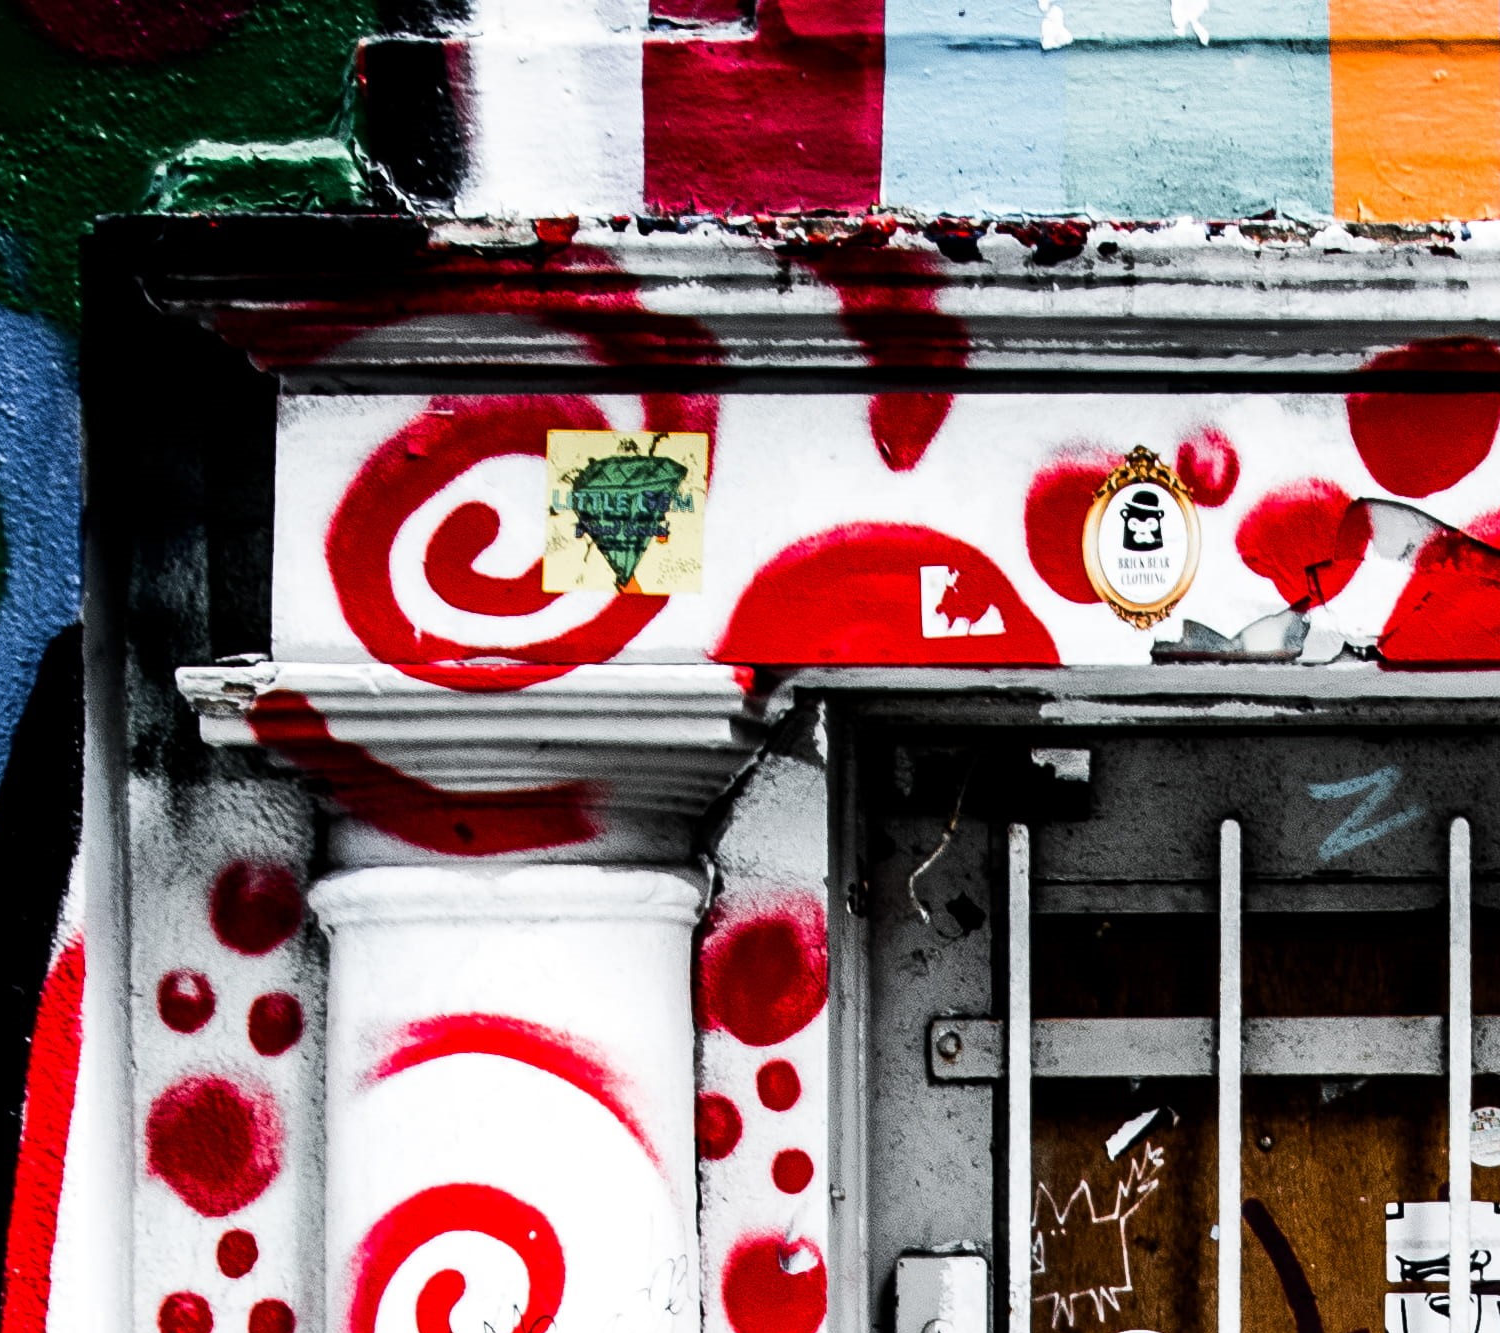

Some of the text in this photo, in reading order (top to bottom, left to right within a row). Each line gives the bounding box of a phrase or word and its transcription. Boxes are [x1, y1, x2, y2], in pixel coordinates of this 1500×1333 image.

[552, 489, 628, 512] LITTLE
[1118, 556, 1170, 570] BRICK BEAR
[1120, 572, 1166, 585] CLOTHING
